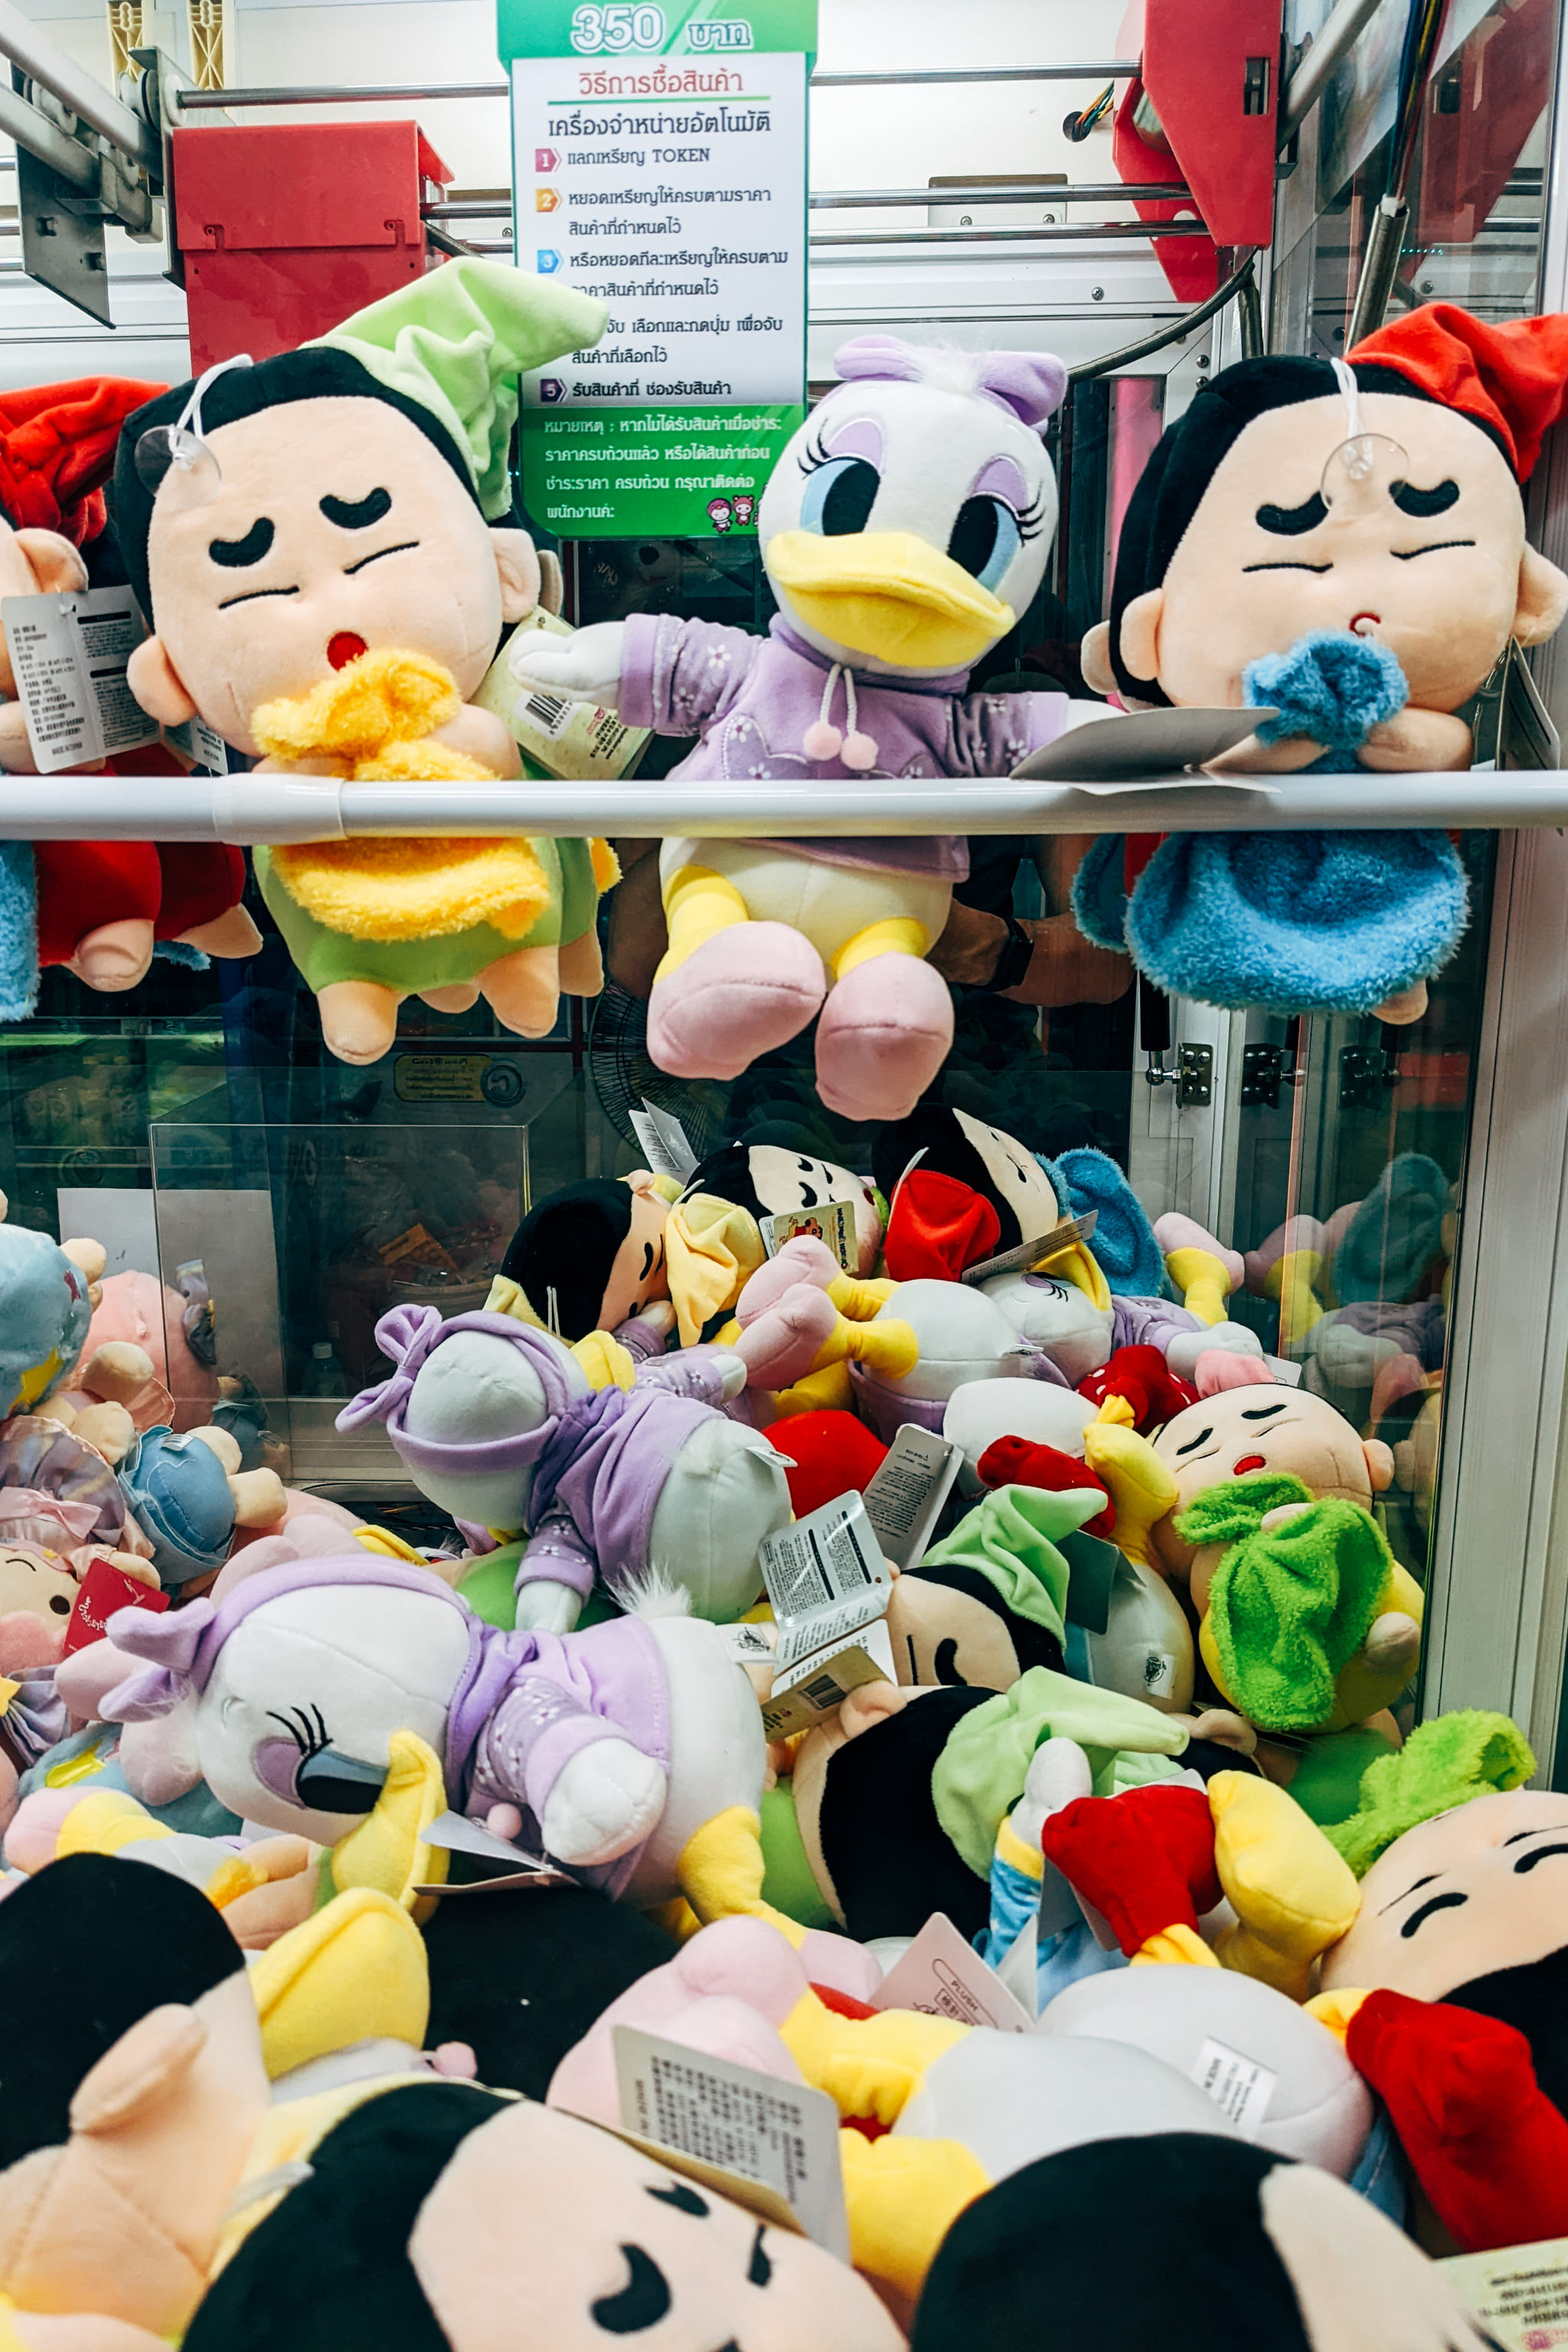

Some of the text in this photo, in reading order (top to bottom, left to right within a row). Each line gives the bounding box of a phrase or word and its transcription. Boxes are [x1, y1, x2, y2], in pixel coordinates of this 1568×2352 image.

[573, 5, 751, 52] 350 บาท
[579, 64, 743, 95] วิธีการซื้อสินค้า
[548, 106, 771, 136] เครื่องจำหน่ายอัตโนมัติ
[542, 149, 710, 167] 1 แลกเหรียญ TOKEN
[542, 185, 772, 207] 2 หยอดเหรียญให้ครบตามราคา
[569, 216, 681, 235] สินค้าที่กำหนดไว้
[543, 254, 553, 268] 3
[572, 277, 719, 296] าคาสินค้าที่กำหนดไว้
[632, 314, 730, 335] เลือกและกดปุ่ม
[737, 313, 783, 332] เพื่อจับ
[547, 378, 732, 397] 5 รับสินค้าที่ ช่องรับสินค้า
[544, 421, 604, 436] หมายเหตุ
[547, 475, 609, 490] ชำระราคา
[615, 473, 669, 489] ครบถ้วน
